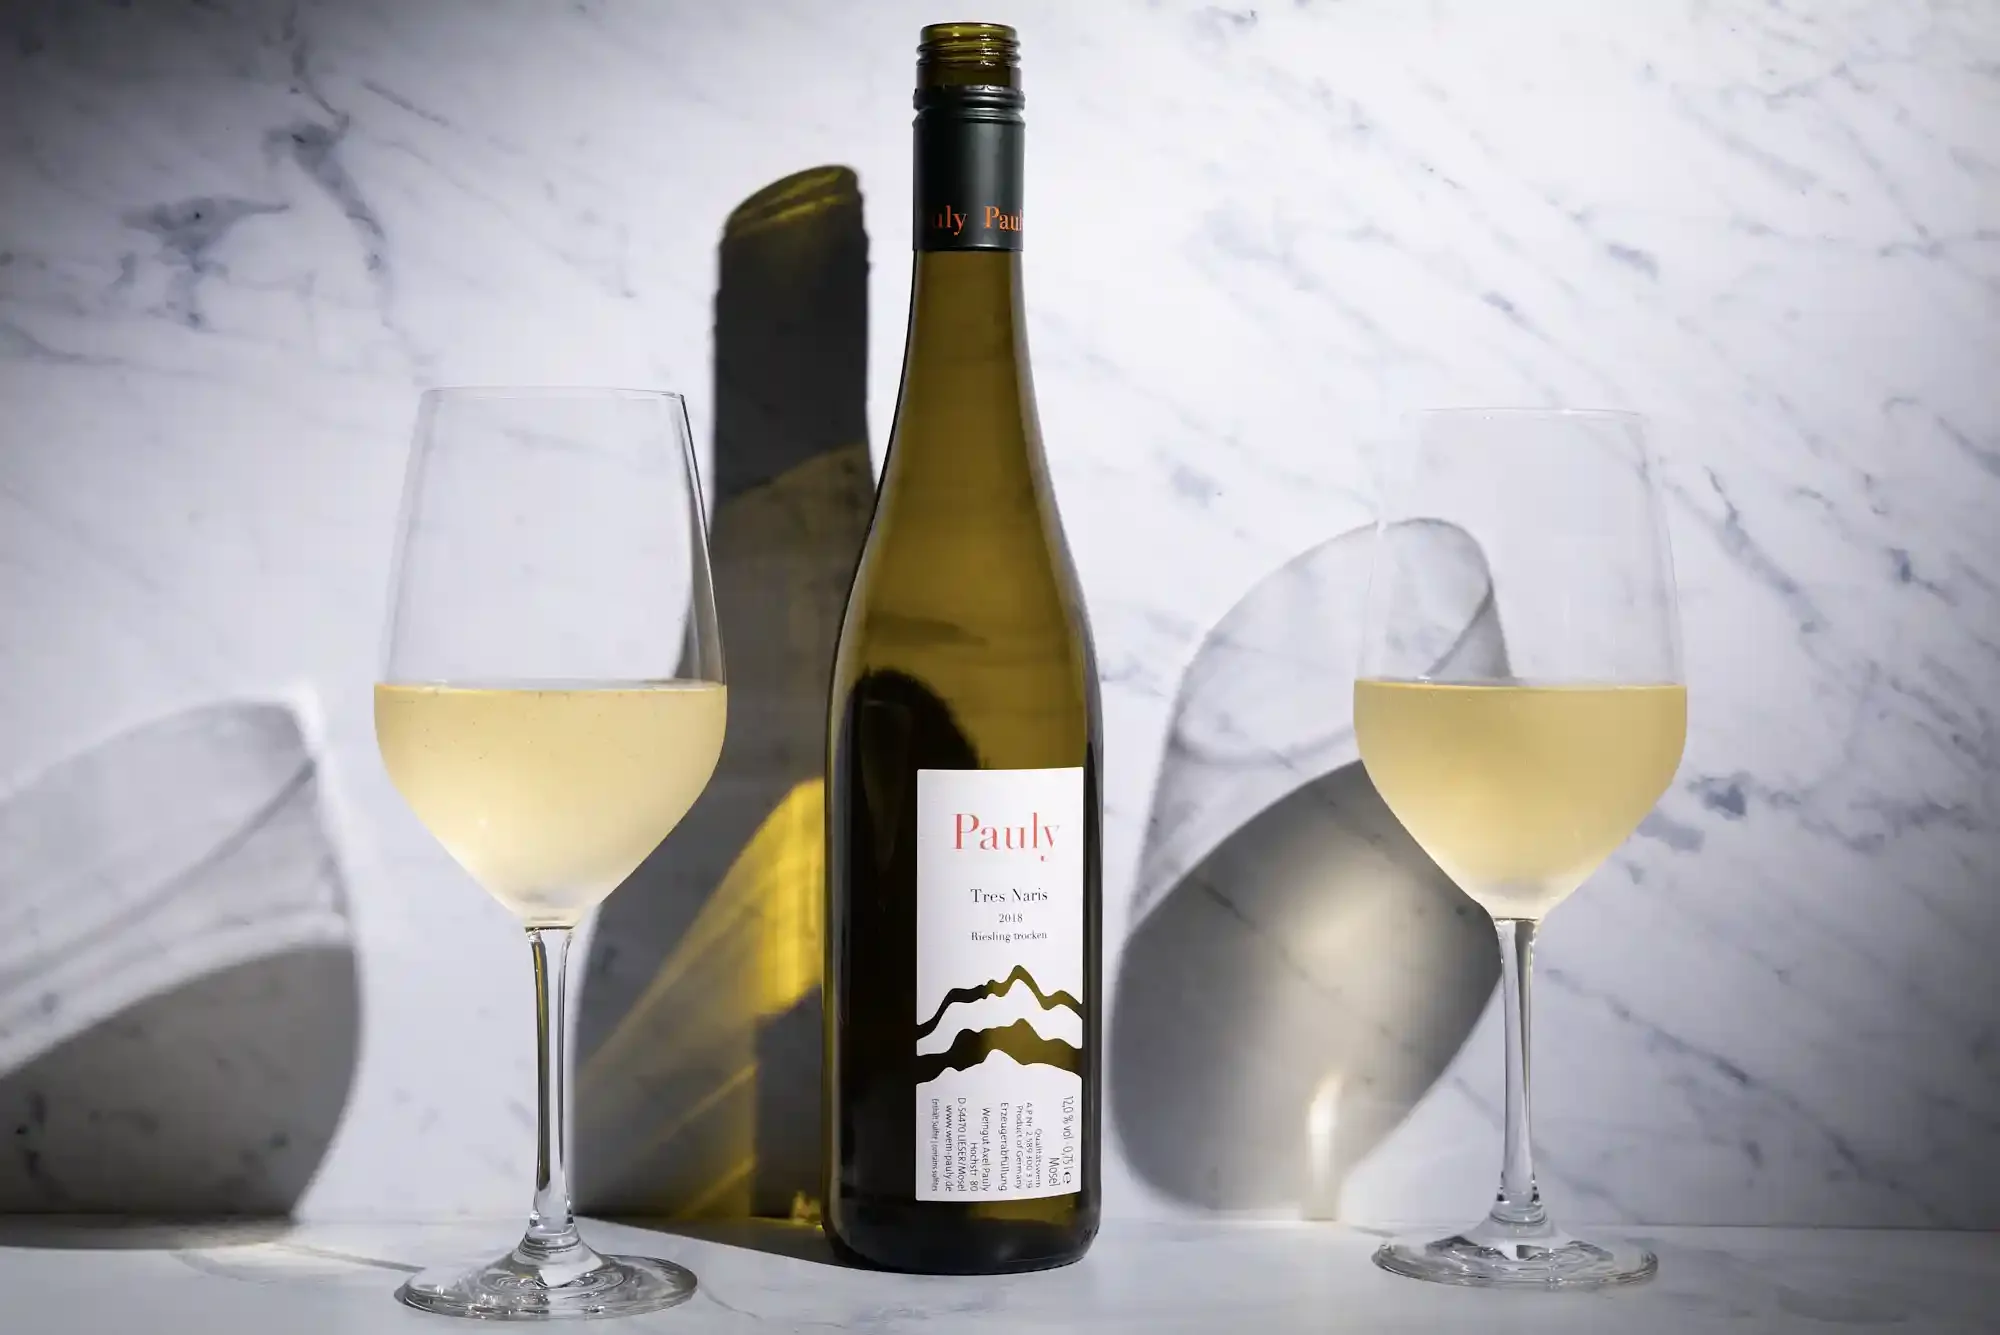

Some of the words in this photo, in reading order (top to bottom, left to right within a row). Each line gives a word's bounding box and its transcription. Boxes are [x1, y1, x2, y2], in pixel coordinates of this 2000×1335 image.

[952, 812, 1060, 862] Pauly
[970, 889, 1006, 903] Tres
[1012, 887, 1048, 902] Naris
[999, 913, 1023, 923] 2018
[971, 931, 1011, 943] Riesling
[1013, 930, 1047, 940] trocken
[1062, 1096, 1073, 1113] 12,0
[980, 1108, 990, 1144] Weingut
[1063, 1115, 1073, 1123] %
[1063, 1126, 1074, 1139] vol
[943, 1105, 954, 1192] www.wein-pauly.de
[1016, 1140, 1023, 1148] of
[957, 1135, 966, 1191] LIESER/Mosel
[982, 1147, 990, 1165] Axel
[1061, 1146, 1073, 1165] 0,75
[1014, 1151, 1023, 1189] Germany
[1048, 1157, 1060, 1187] Mosel
[970, 1180, 978, 1191] 80
[981, 1168, 990, 1191] Pauly
